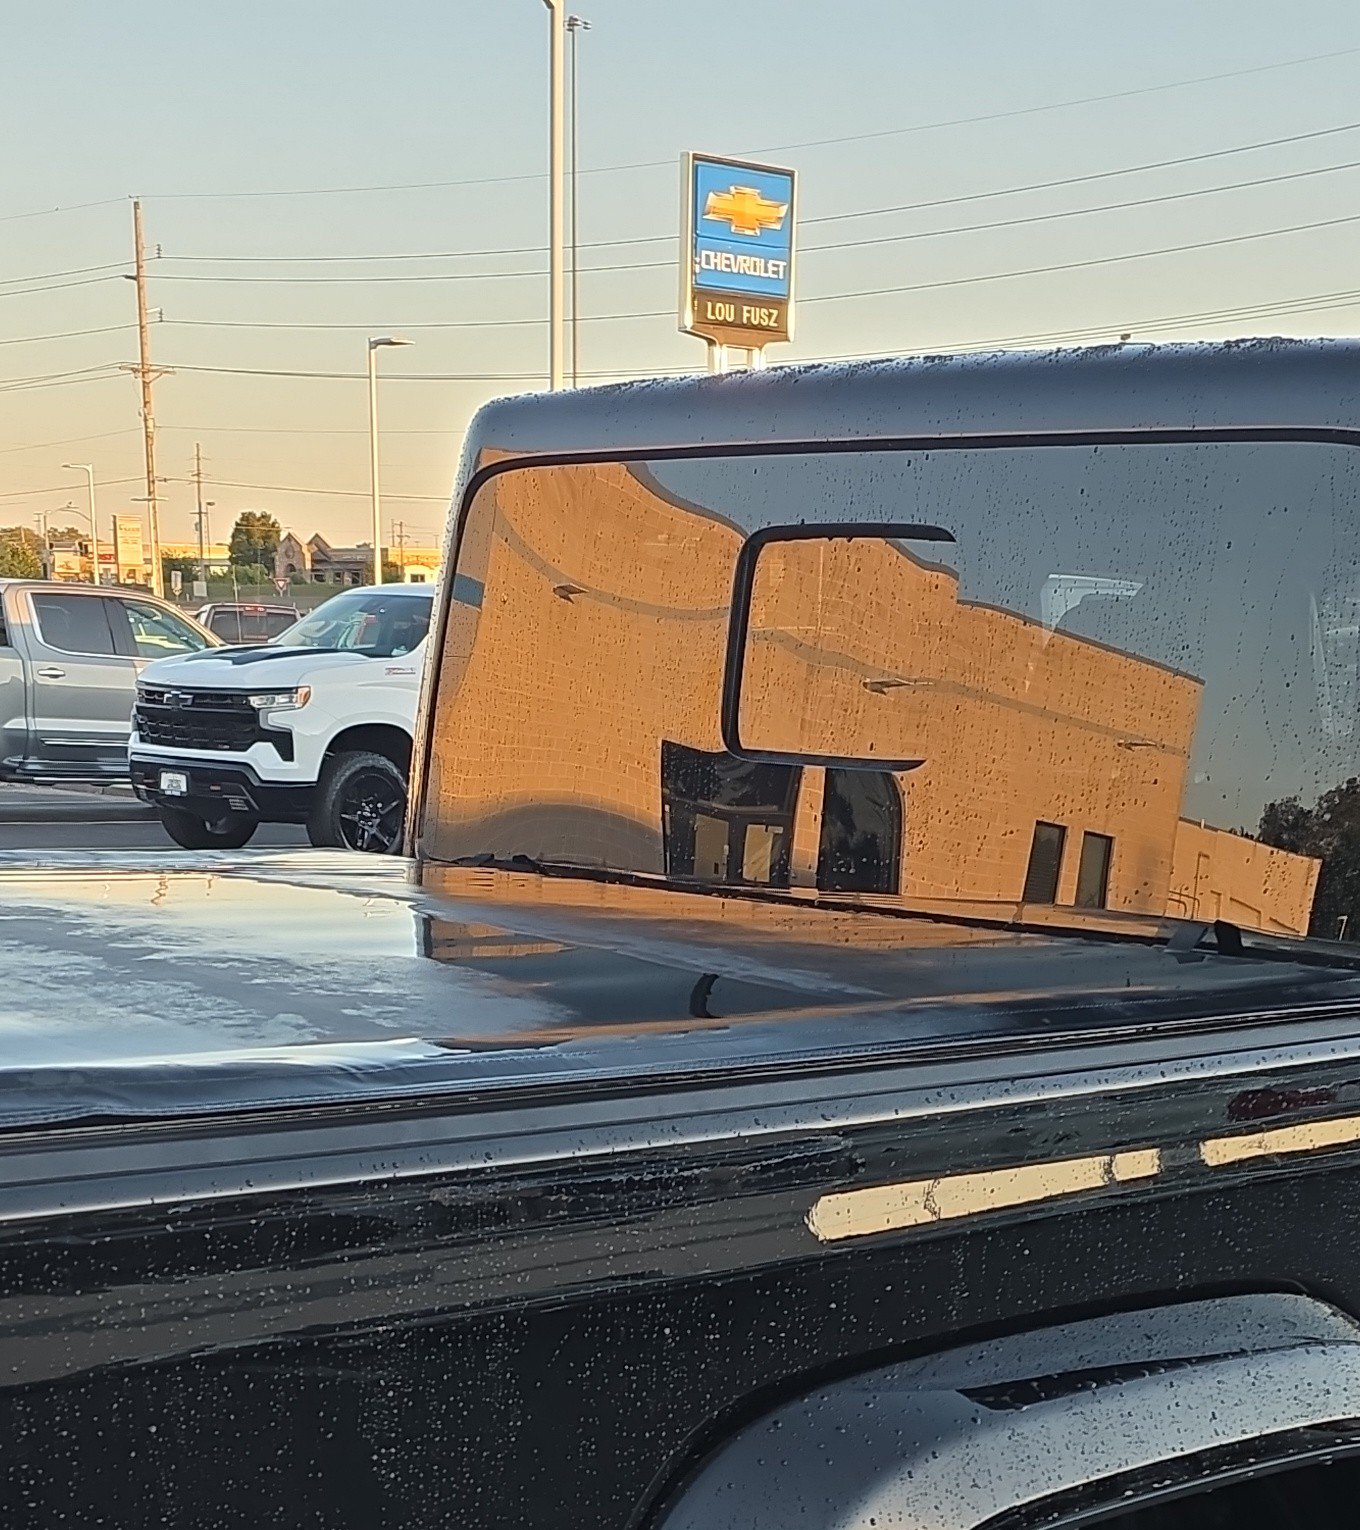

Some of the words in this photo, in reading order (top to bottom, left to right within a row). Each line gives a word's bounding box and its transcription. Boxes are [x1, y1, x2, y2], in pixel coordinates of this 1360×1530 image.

[700, 250, 787, 280] CHEVROLET
[706, 301, 735, 323] LOU
[742, 305, 779, 328] FUSZ
